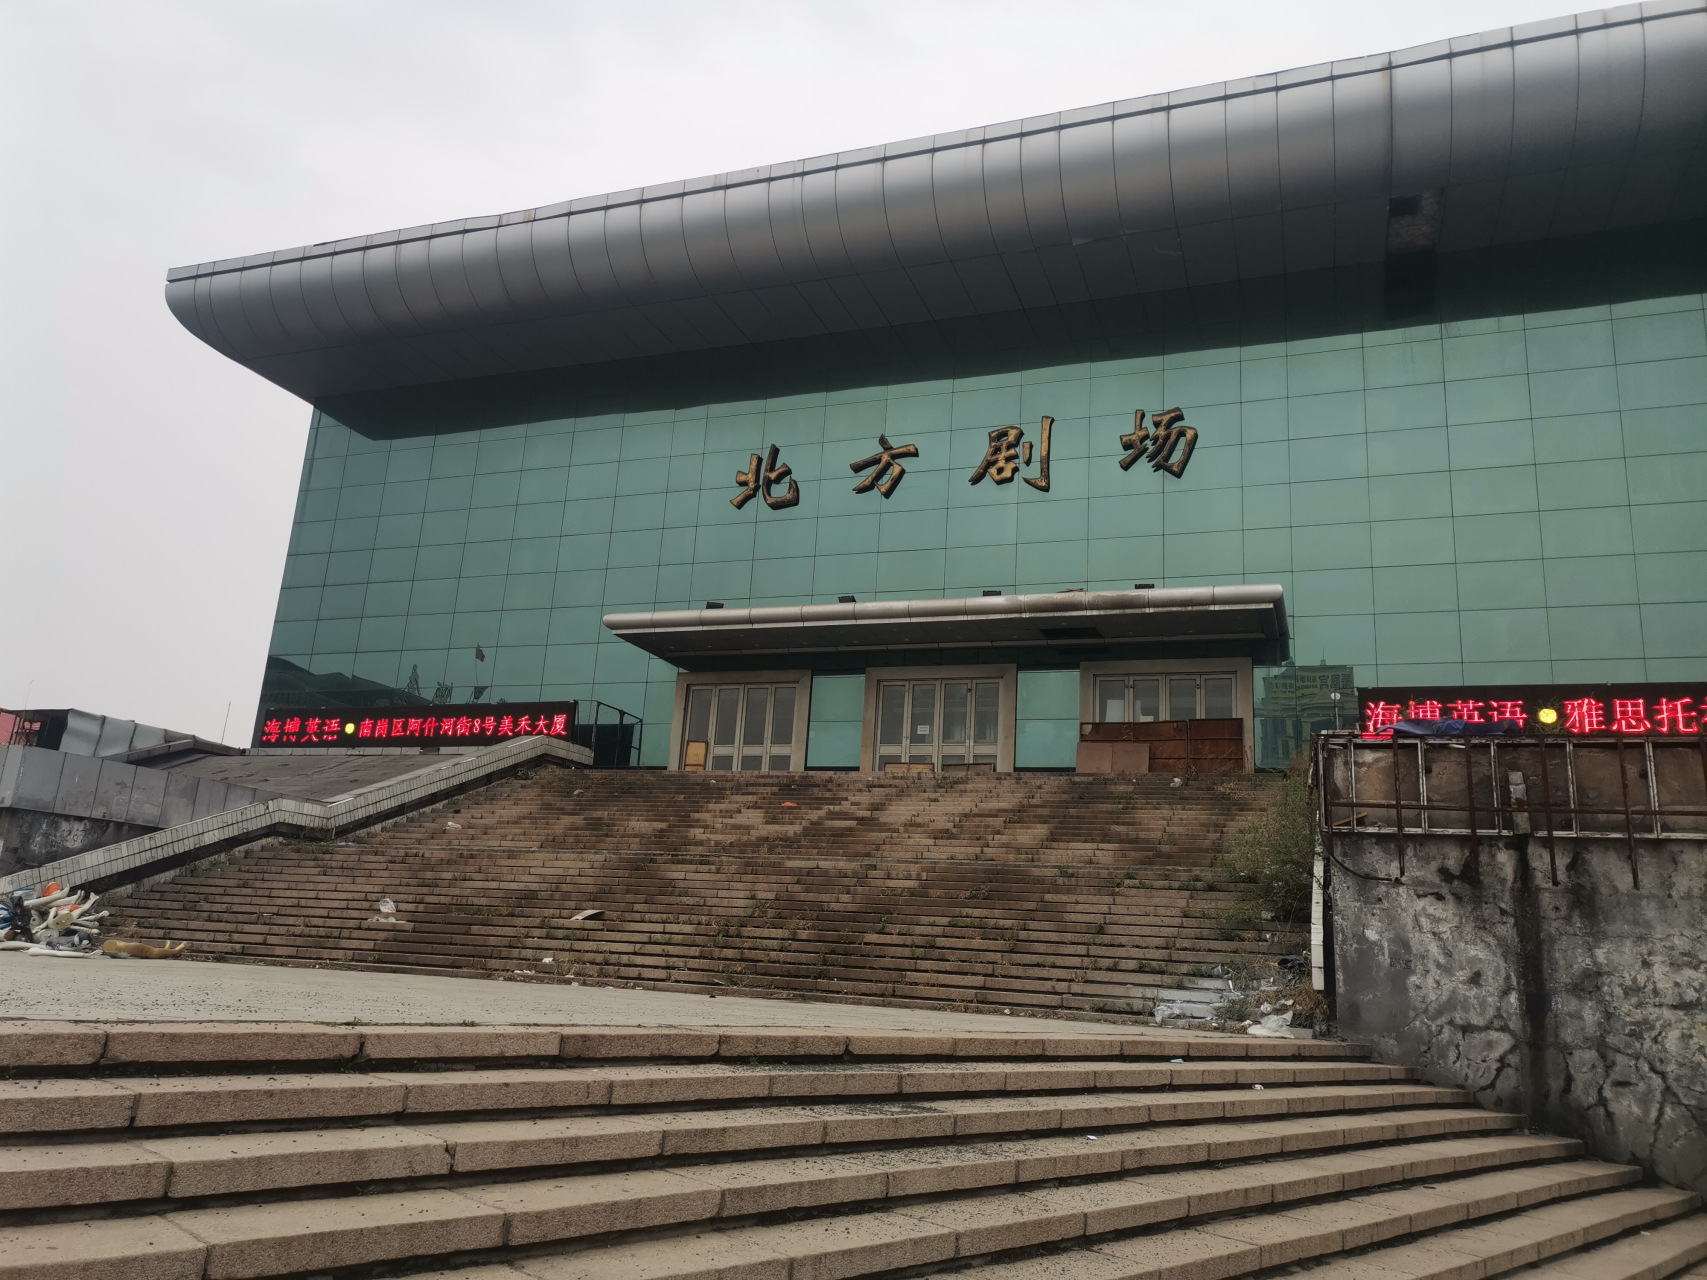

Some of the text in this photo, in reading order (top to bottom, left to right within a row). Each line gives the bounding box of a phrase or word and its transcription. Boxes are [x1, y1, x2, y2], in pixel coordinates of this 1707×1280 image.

[730, 407, 1198, 510] 北方剧场
[358, 714, 568, 738] 南岗区阿什河街8号美禾大厦
[1563, 697, 1707, 734] 雅思托
